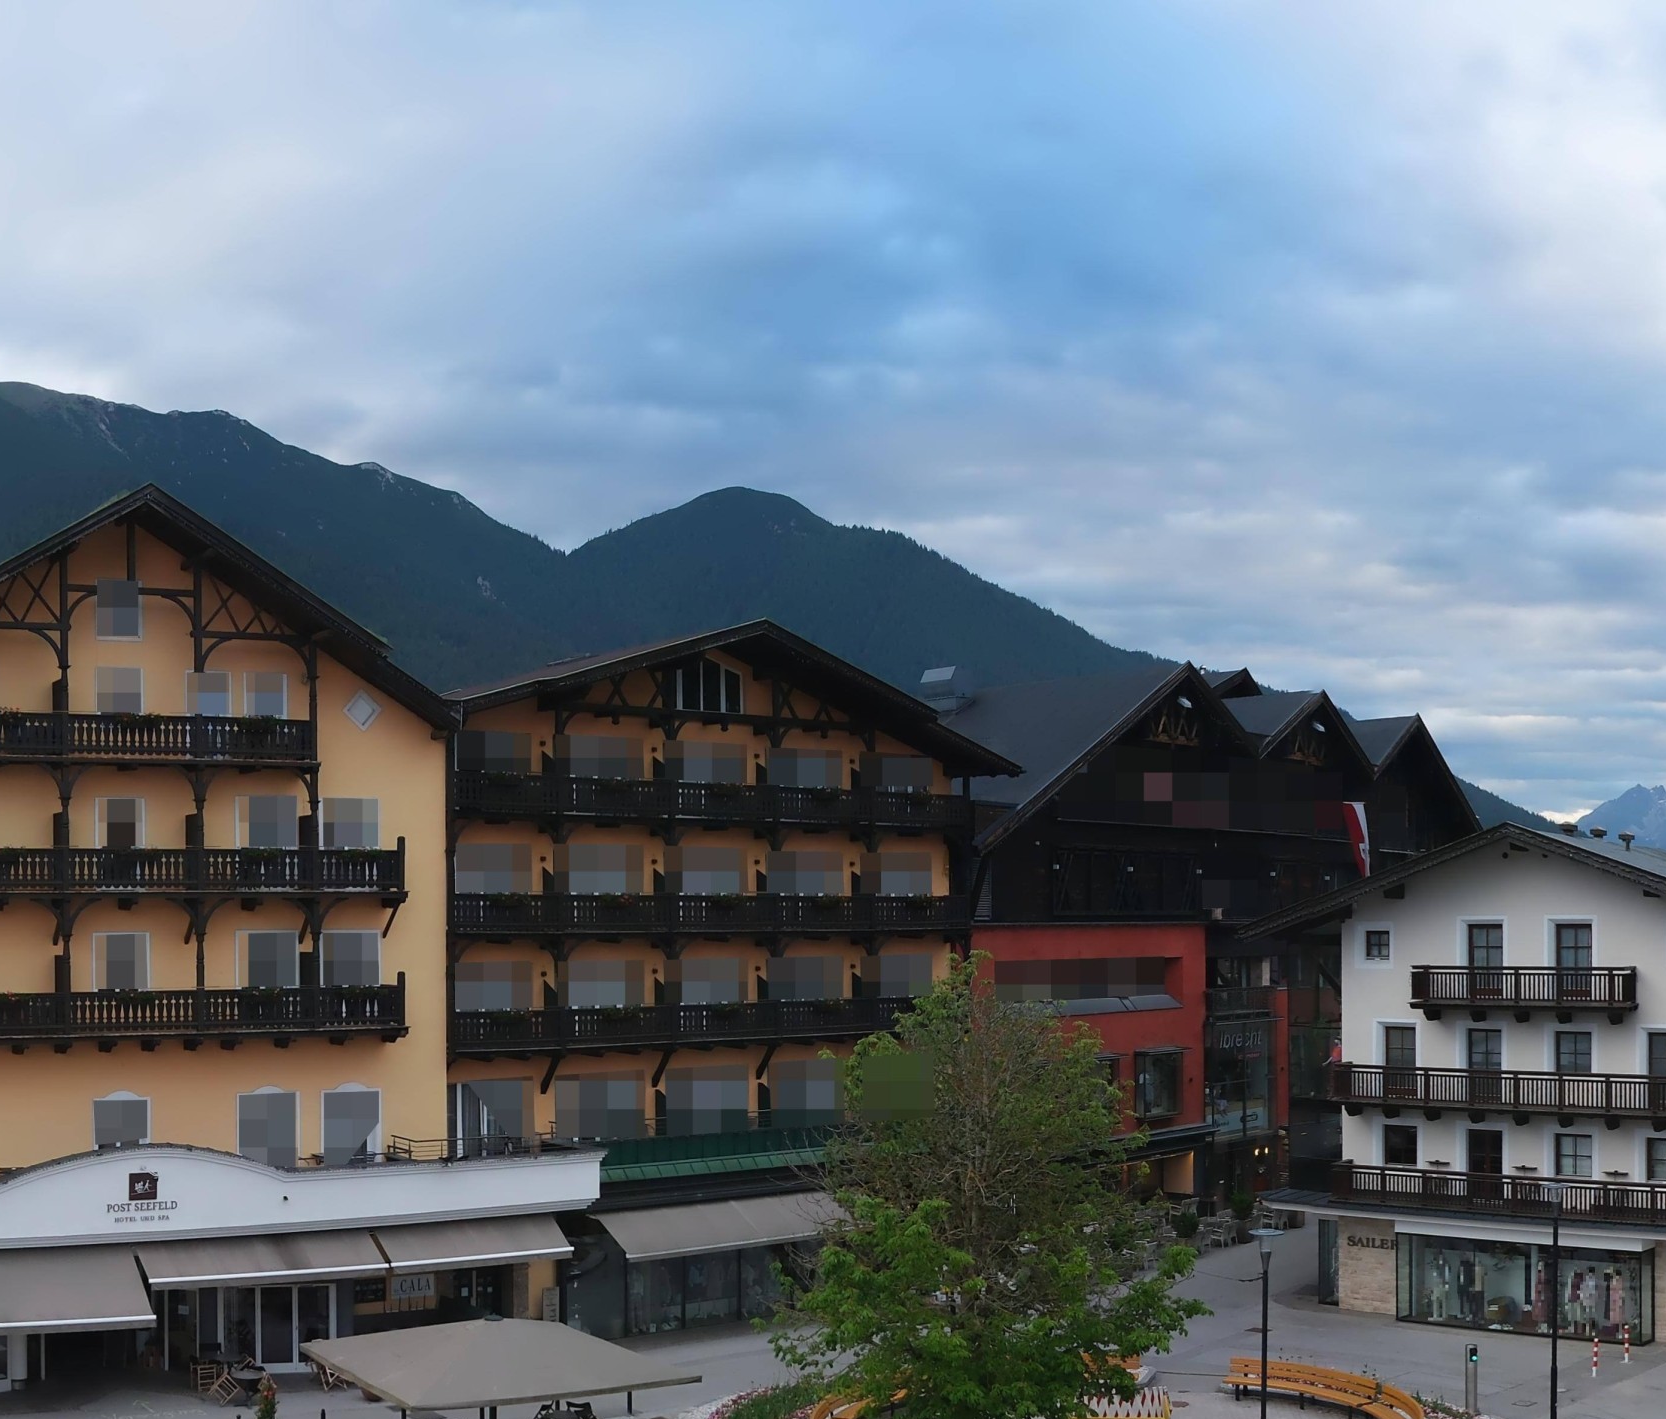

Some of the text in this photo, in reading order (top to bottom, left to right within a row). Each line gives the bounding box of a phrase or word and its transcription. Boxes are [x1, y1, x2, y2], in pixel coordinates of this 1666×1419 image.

[107, 1201, 178, 1213] POST SEEFELD
[399, 1277, 431, 1293] CALA
